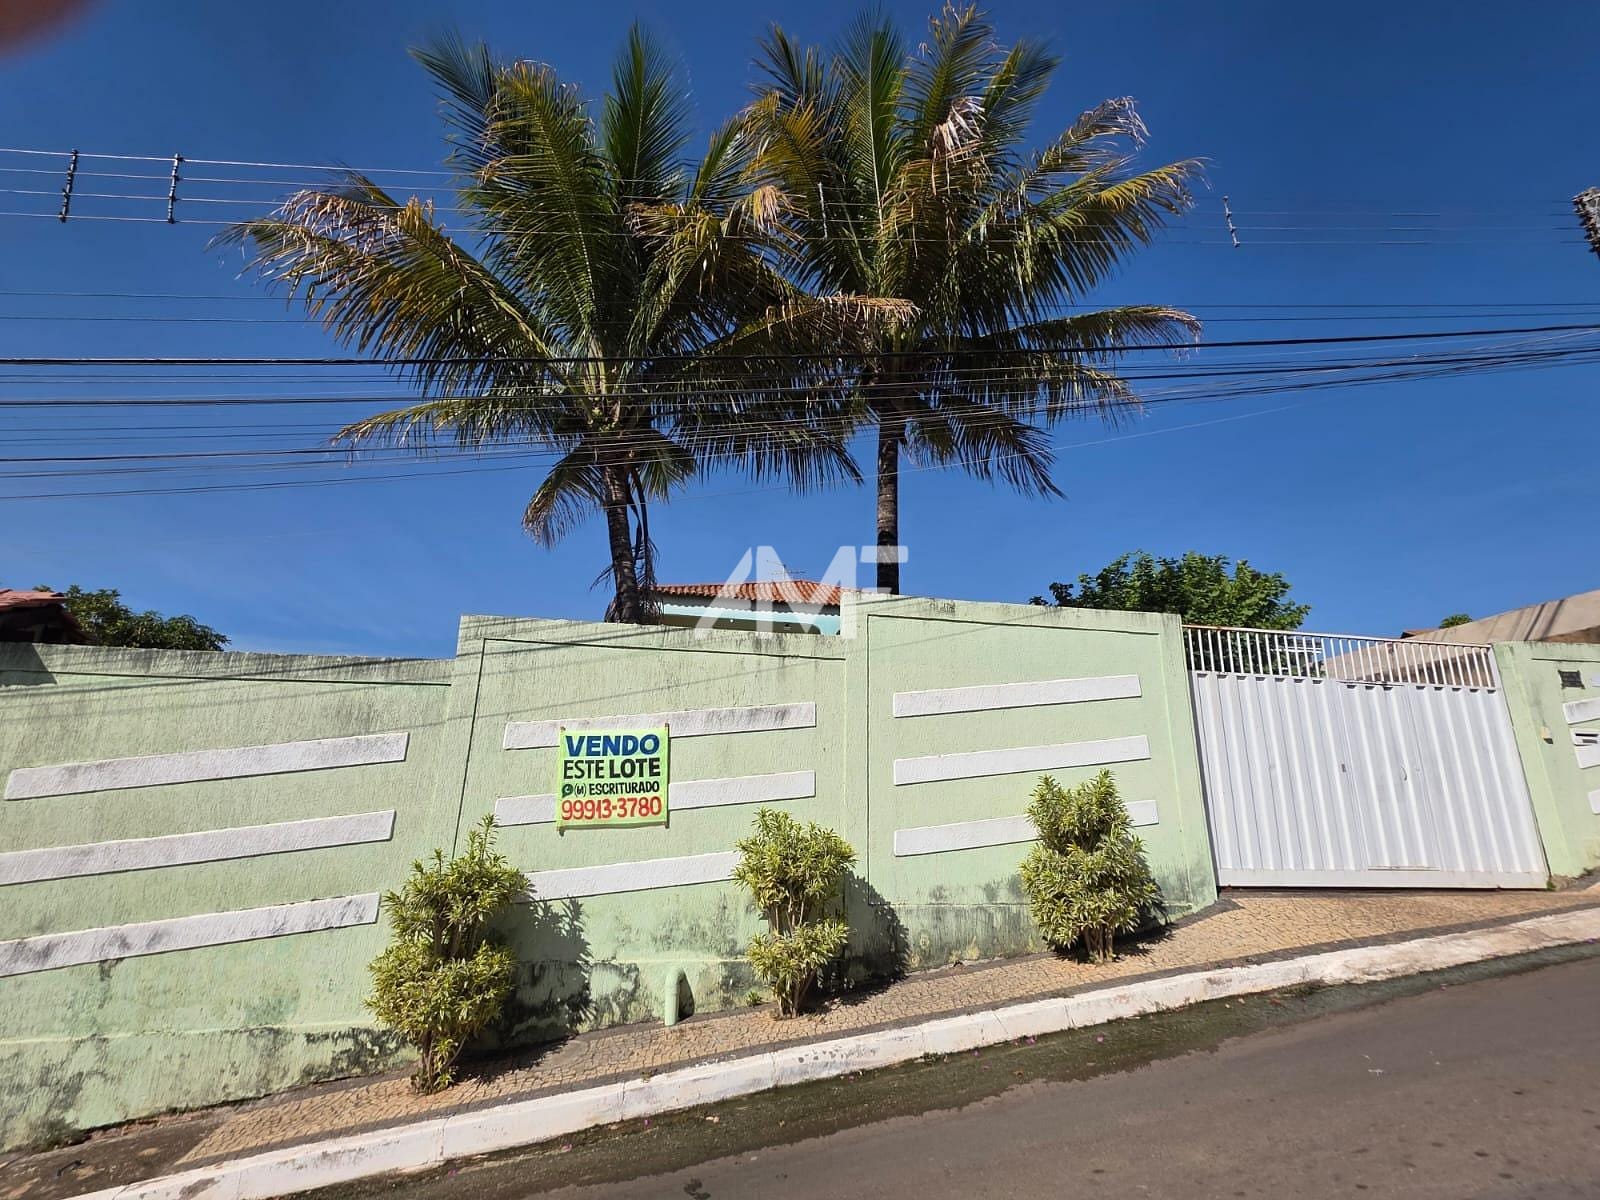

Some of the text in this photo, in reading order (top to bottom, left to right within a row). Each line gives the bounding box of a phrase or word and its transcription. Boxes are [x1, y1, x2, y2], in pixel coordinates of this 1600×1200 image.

[565, 734, 660, 757] VENDO
[563, 757, 660, 779] ESTE LOTE
[589, 781, 660, 796] ESCRITURADO
[561, 796, 662, 820] 99913-3780
